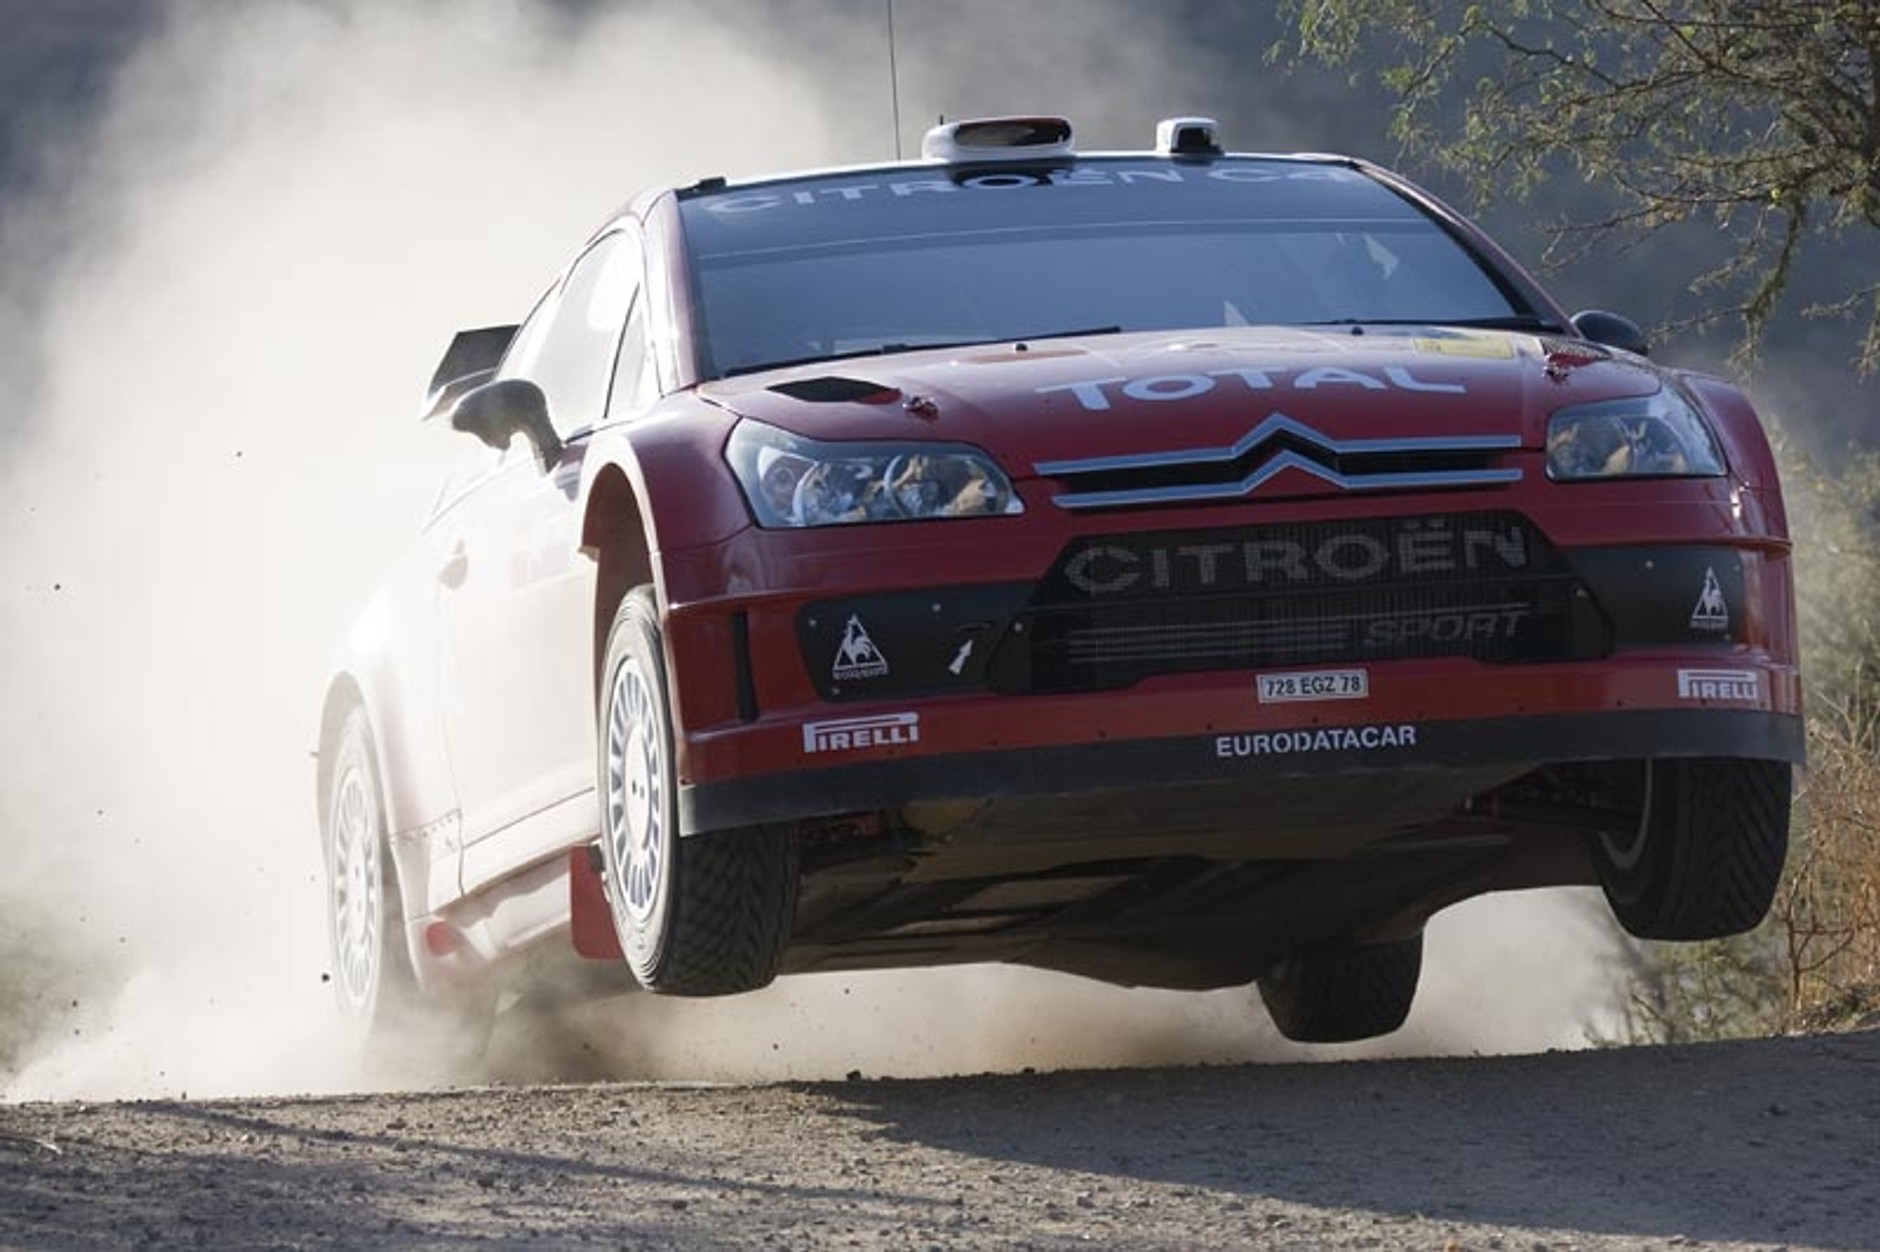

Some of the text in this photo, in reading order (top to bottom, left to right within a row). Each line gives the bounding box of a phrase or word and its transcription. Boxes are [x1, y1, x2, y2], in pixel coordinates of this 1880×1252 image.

[1034, 366, 1465, 410] TOTAL
[1064, 518, 1527, 592] CITROËN
[1363, 609, 1530, 647] SPORT
[1267, 675, 1360, 696] 728 EGZ 78
[1677, 668, 1758, 699] PIRELLI
[803, 712, 919, 753] PIRELLI
[1215, 725, 1417, 757] EURODATACAR
